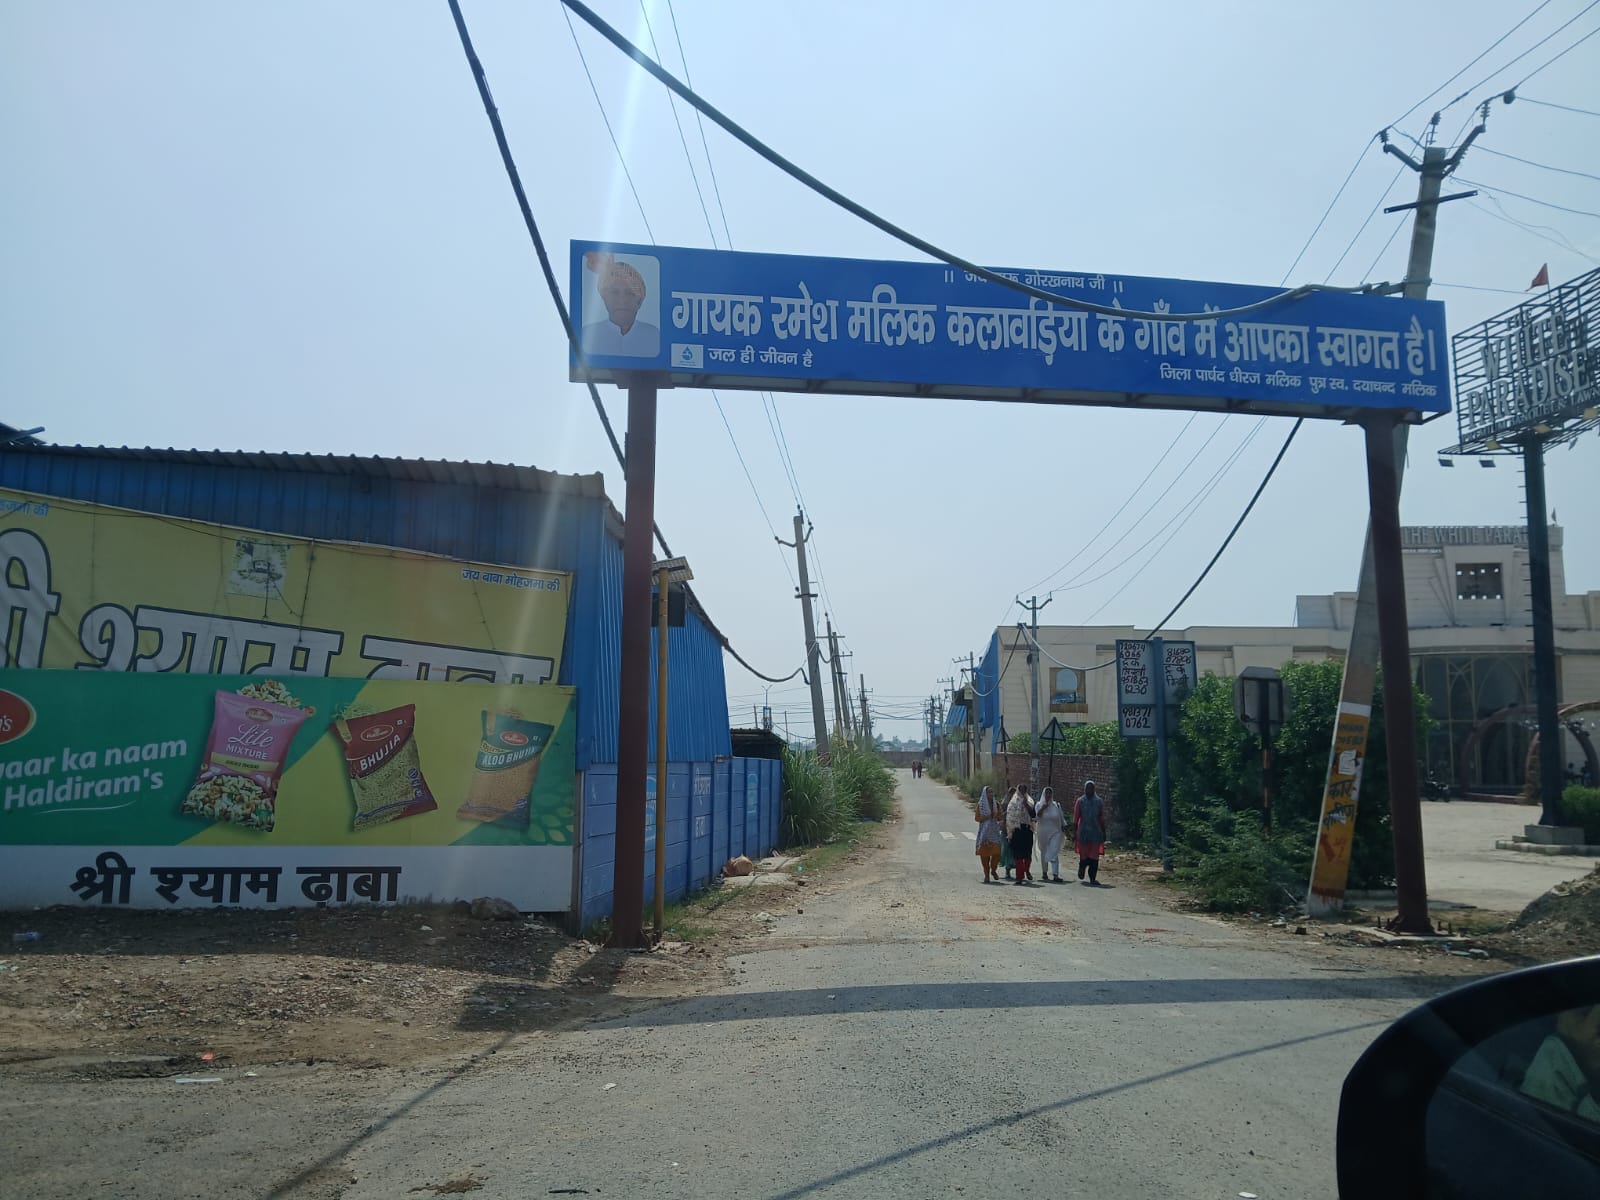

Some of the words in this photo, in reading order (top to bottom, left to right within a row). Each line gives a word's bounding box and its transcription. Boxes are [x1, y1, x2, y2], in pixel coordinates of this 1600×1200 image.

[1025, 271, 1084, 288] गोरखनाथ
[1088, 274, 1105, 290] जी
[671, 291, 763, 336] गायक
[771, 282, 839, 342] रमेश
[846, 284, 937, 346] मलिक
[946, 296, 1088, 366] कलावड़िया
[1097, 297, 1126, 353] के
[1133, 298, 1187, 357] गाँव
[1193, 302, 1220, 359] में
[1223, 321, 1310, 365] आपका
[1317, 325, 1401, 371] स्वागत
[707, 347, 736, 364] जल
[740, 345, 756, 366] ही
[759, 348, 798, 367] जीवन
[802, 348, 814, 368] है
[1480, 310, 1569, 382] WHITE
[1160, 362, 1192, 381] जिला
[1195, 365, 1225, 383] पार्षद
[1229, 366, 1261, 385] धीरज
[1265, 370, 1302, 388] मलिक
[1309, 376, 1326, 394] पुत्र
[1402, 379, 1437, 397] मलिक
[1467, 347, 1590, 430] PARADISE
[1403, 527, 1427, 545] THE
[1434, 526, 1479, 545] WHITE
[462, 568, 480, 581] जय
[482, 572, 503, 585] बाबा
[546, 577, 560, 591] की
[228, 723, 274, 748] Lite
[1125, 717, 1151, 729] 0762
[62, 747, 97, 772] ka
[104, 739, 187, 766] naam
[226, 744, 268, 760] MIXTURE
[359, 734, 401, 771] BHUJIA
[4, 768, 164, 810] Haldiram's
[69, 851, 136, 905] श्री
[150, 866, 282, 904] श्याम
[296, 866, 402, 907] ढाबा
